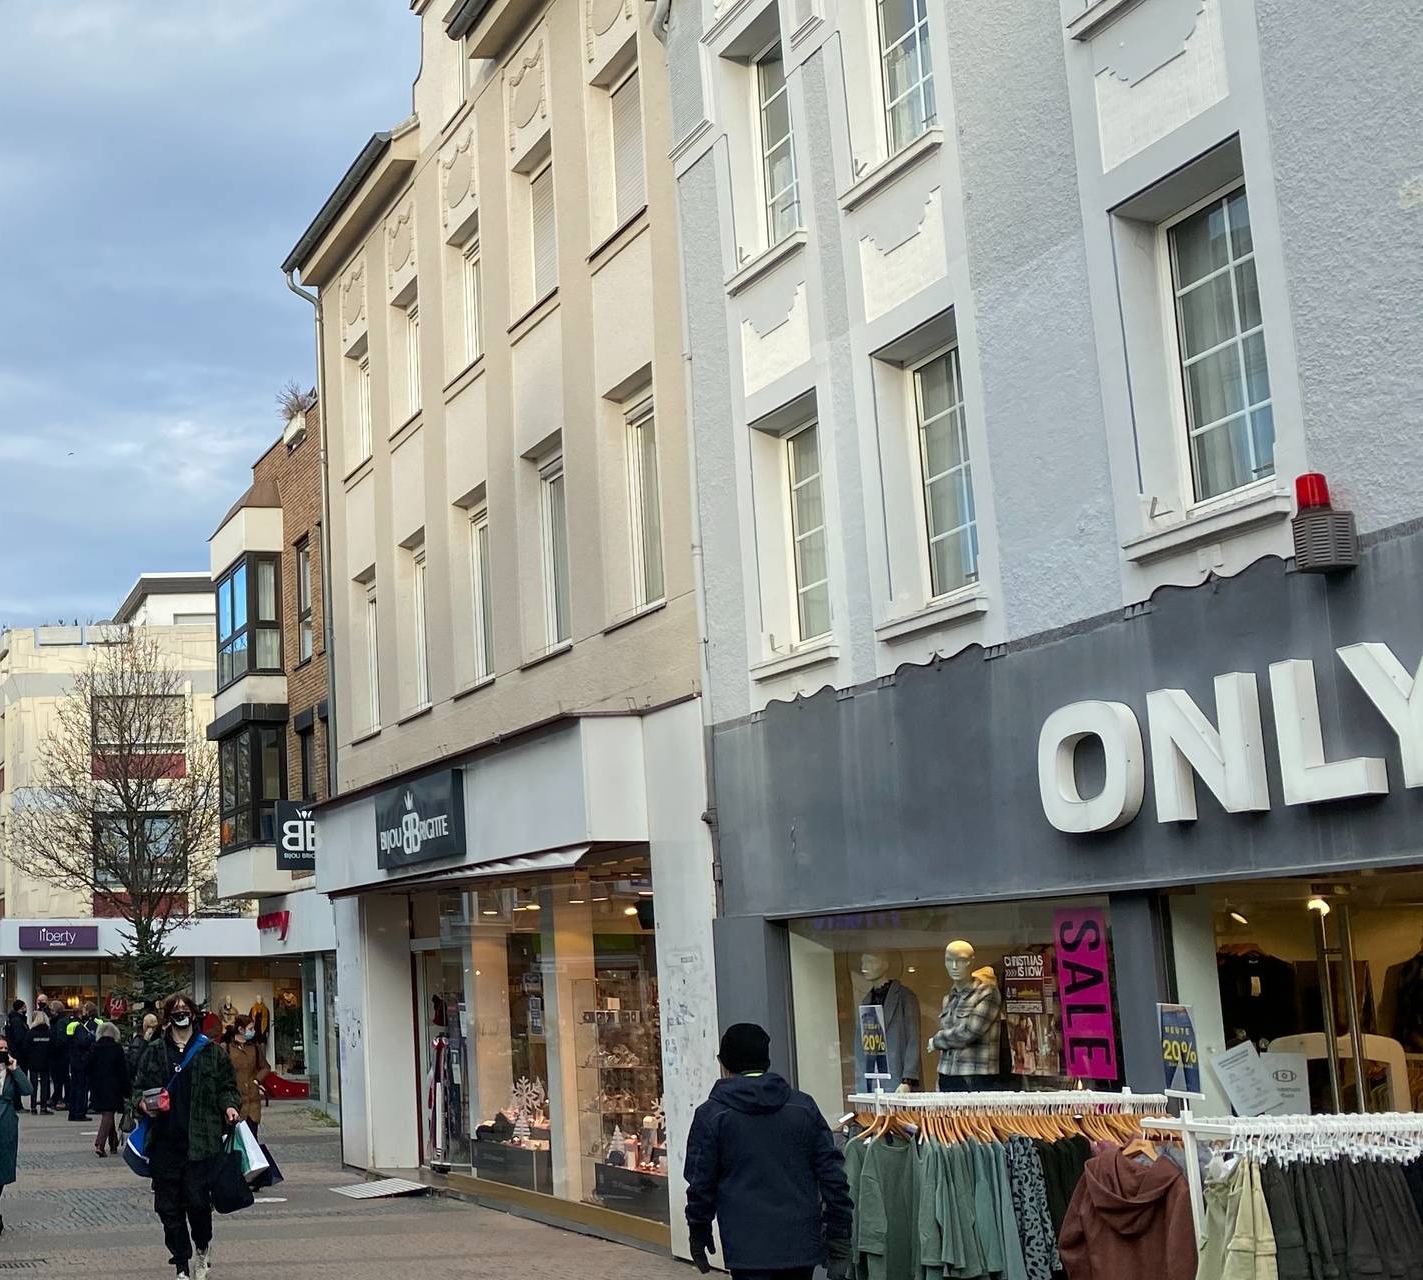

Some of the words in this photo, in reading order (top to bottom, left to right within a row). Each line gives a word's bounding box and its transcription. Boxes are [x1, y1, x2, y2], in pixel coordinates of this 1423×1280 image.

[1038, 642, 1423, 833] ONLY
[380, 826, 402, 854] BIJOU
[39, 927, 76, 944] liberty
[1004, 955, 1044, 967] CHRISTMAS
[1059, 920, 1112, 1066] SALE
[1164, 1026, 1191, 1036] HEUTE
[863, 1034, 886, 1051] 20%
[1162, 1039, 1197, 1064] 20%
